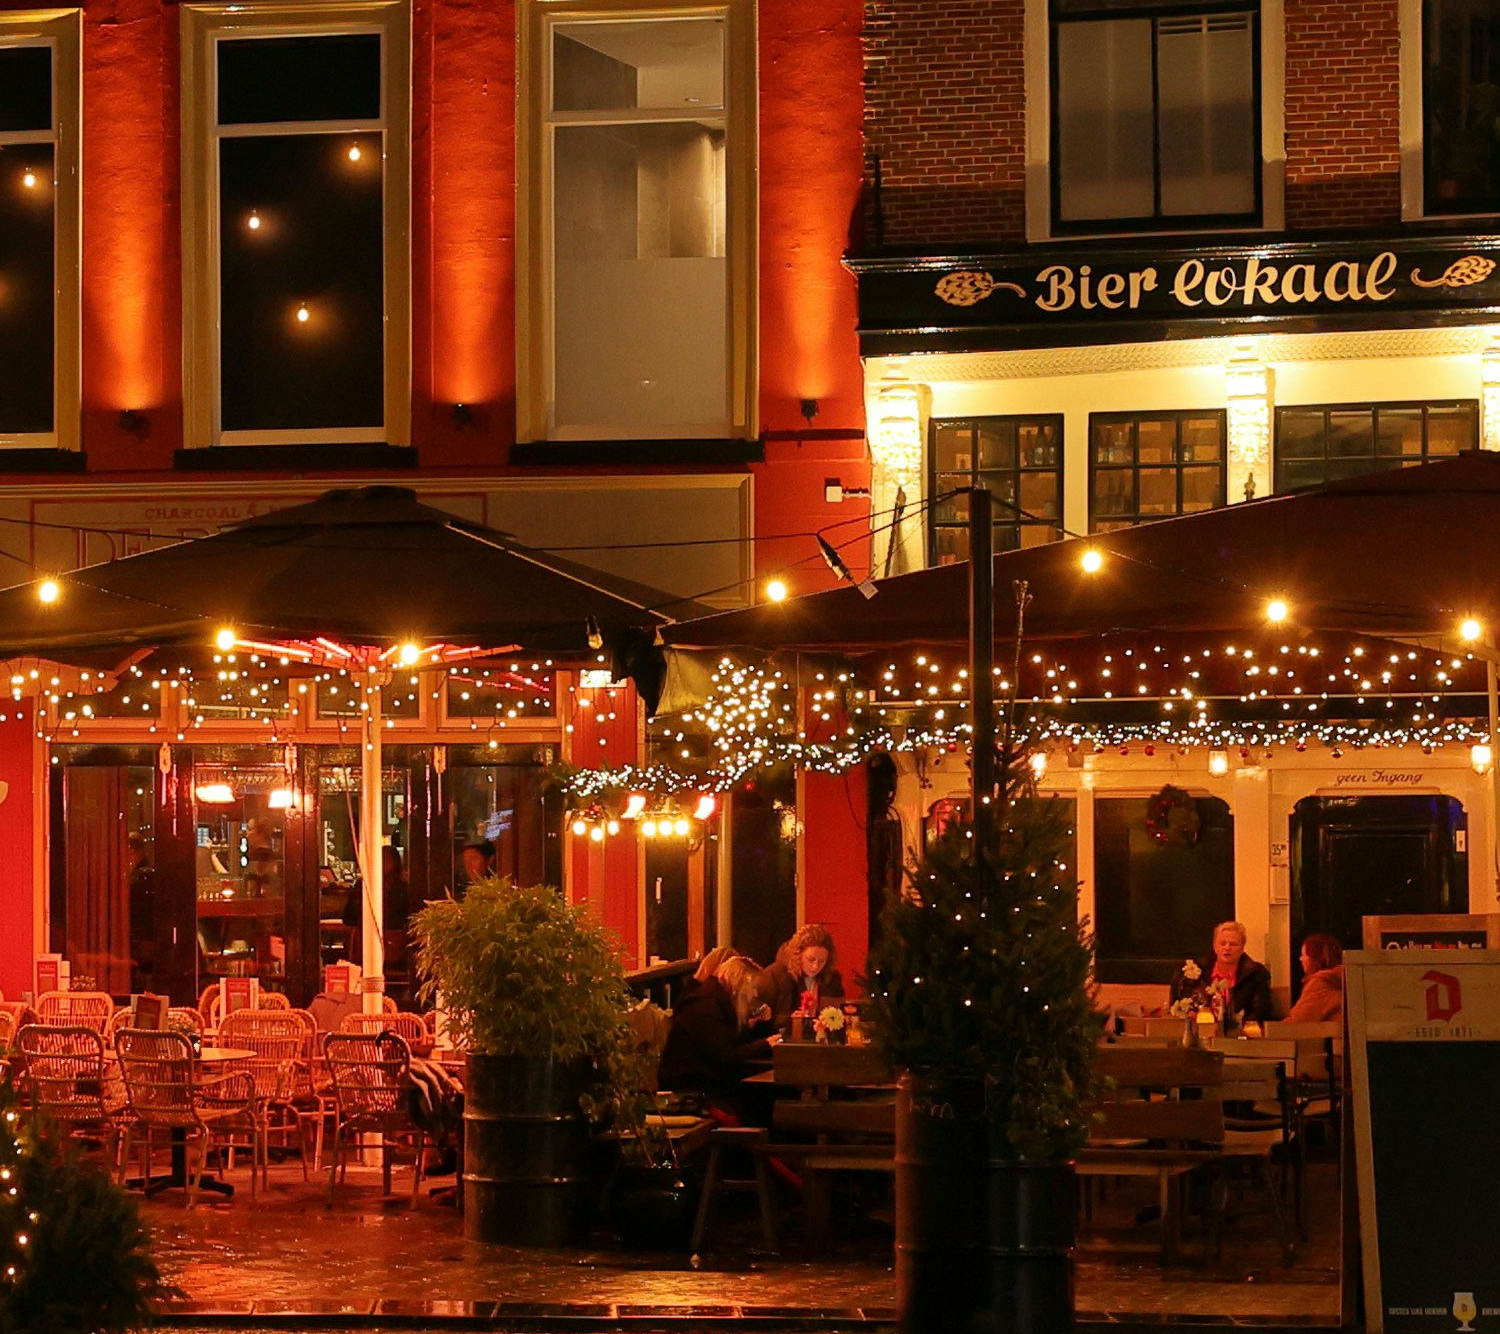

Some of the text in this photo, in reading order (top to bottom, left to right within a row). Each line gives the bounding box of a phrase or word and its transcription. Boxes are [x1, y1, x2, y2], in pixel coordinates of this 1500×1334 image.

[1035, 249, 1397, 311] Bier lokaal
[144, 506, 241, 520] CHARCOAL
[1333, 771, 1423, 787] geen Ingang
